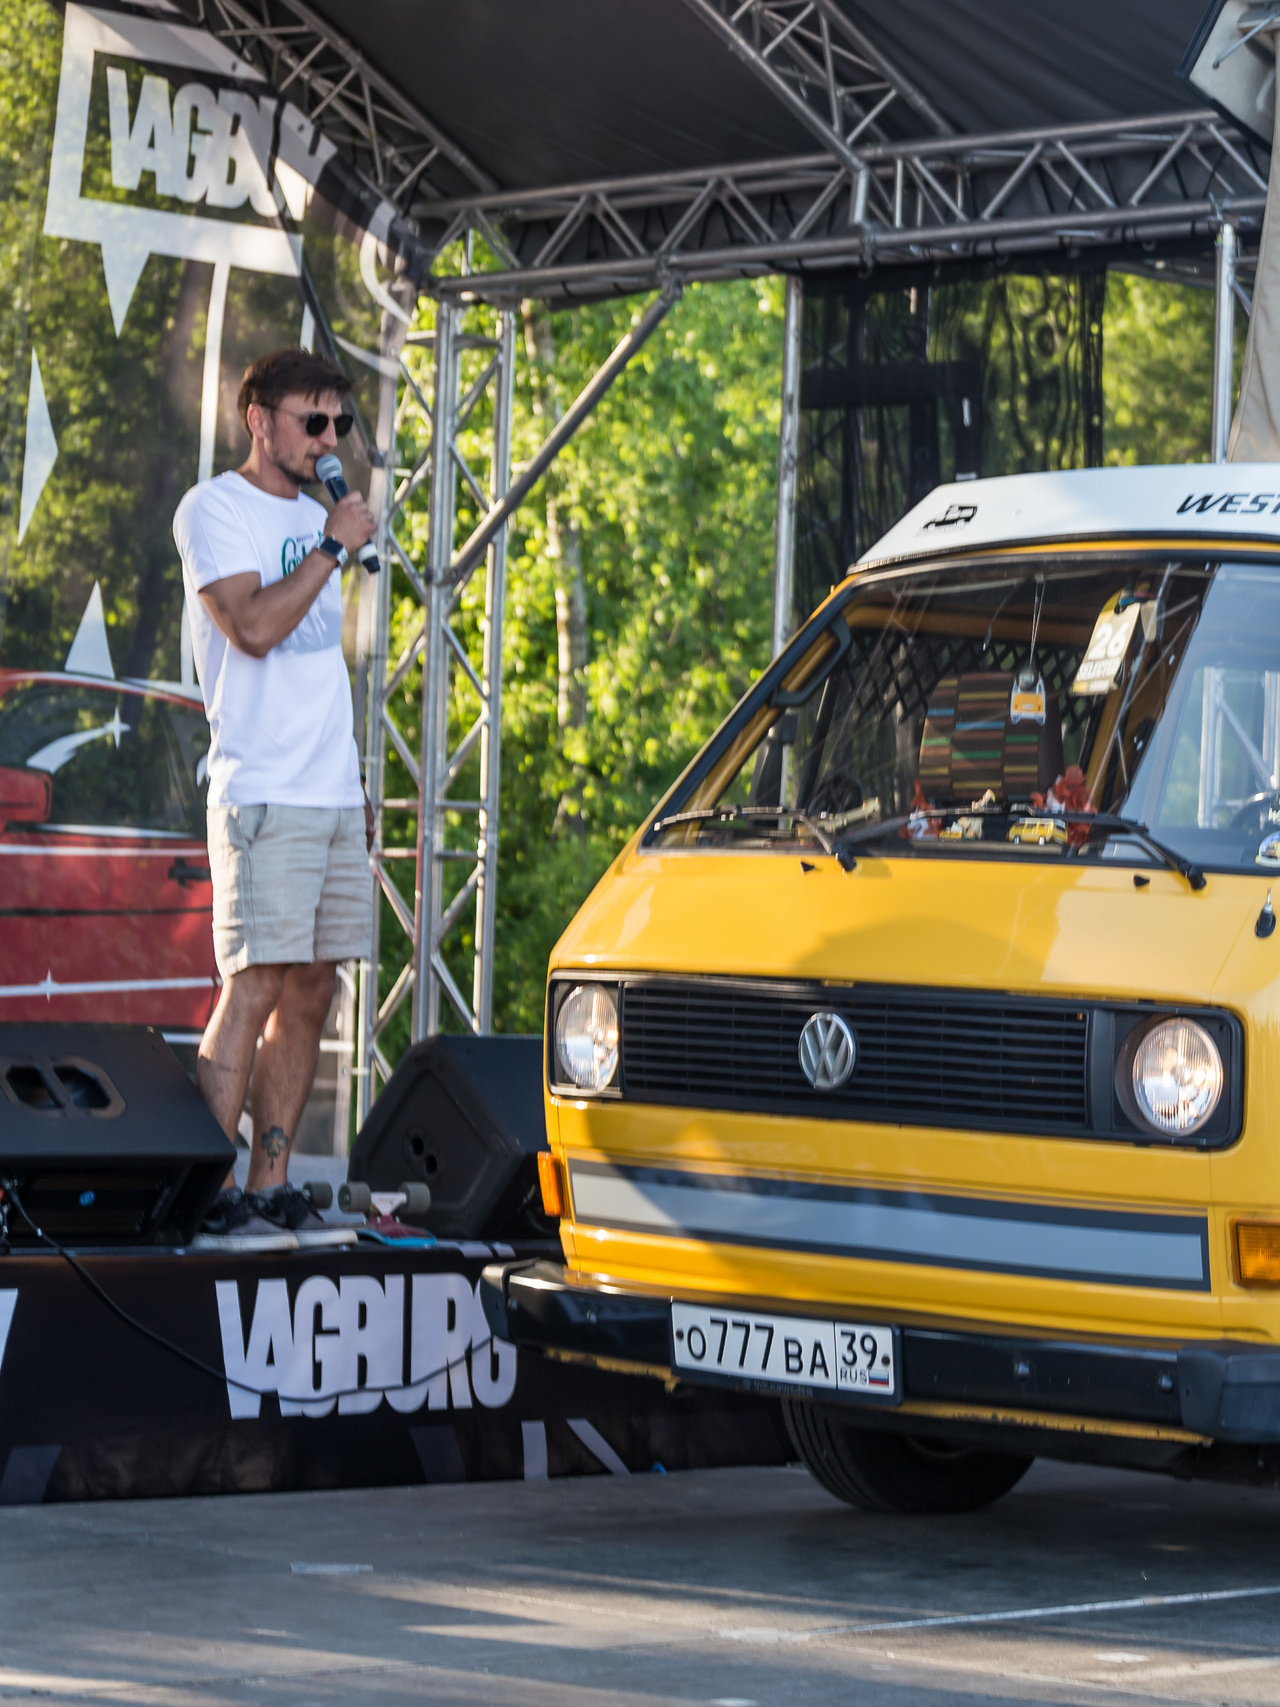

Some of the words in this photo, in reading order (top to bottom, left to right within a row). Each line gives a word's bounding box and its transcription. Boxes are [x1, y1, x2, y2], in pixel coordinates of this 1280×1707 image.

[1087, 621, 1130, 660] 26
[840, 1330, 878, 1369] 39
[840, 1368, 868, 1385] RUS
